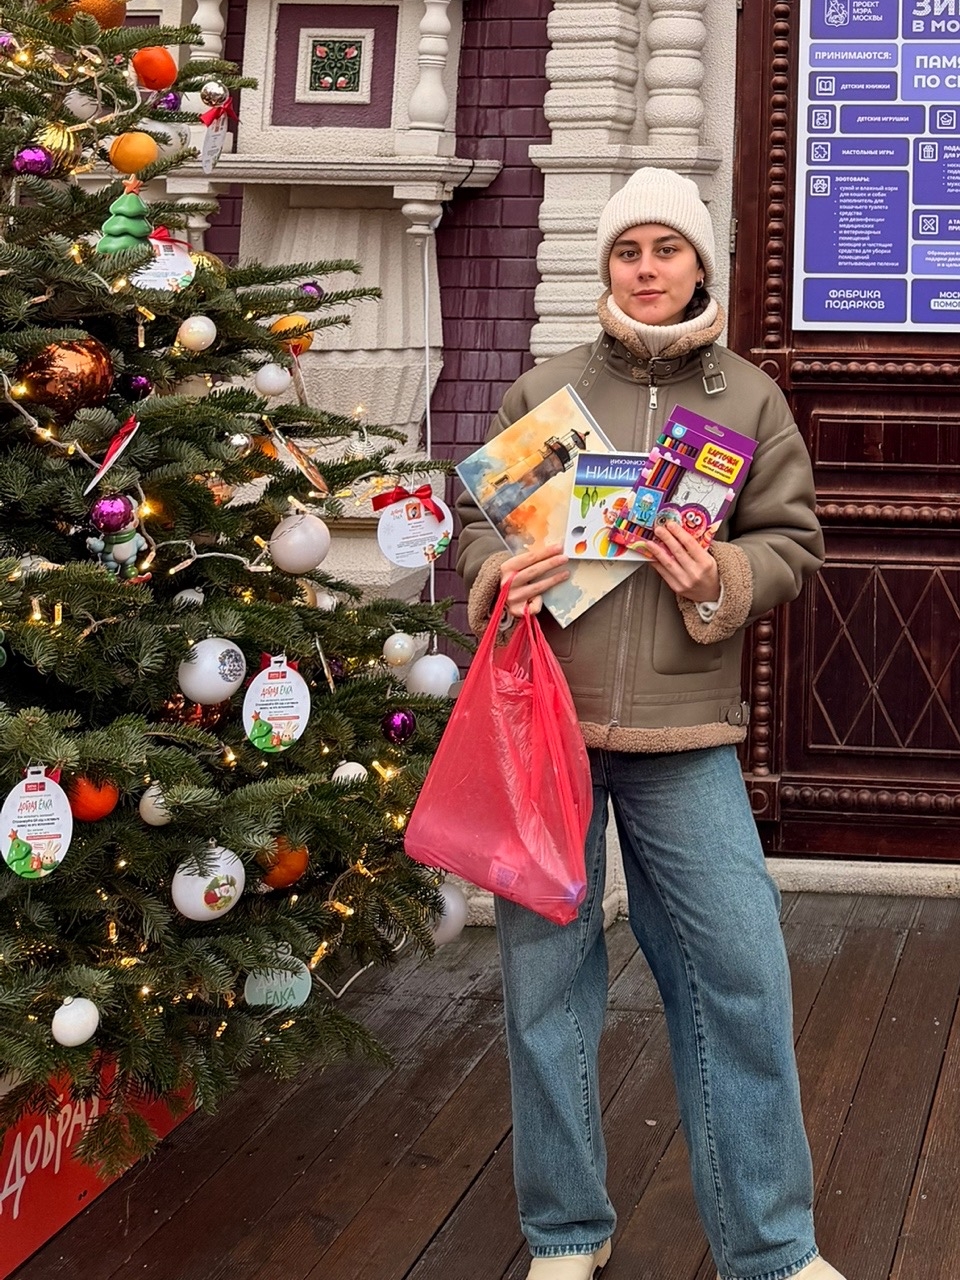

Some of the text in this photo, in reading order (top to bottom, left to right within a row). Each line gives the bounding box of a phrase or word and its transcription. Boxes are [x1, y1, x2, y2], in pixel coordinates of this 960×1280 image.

[912, 20, 924, 32] В
[814, 51, 892, 60] ПРИНИМАЮТСЯ:
[913, 75, 940, 88] ПО
[829, 290, 881, 299] ФАБРИКА
[825, 300, 885, 310] ПОДАРКОВ
[586, 466, 642, 480] ТИЛИН
